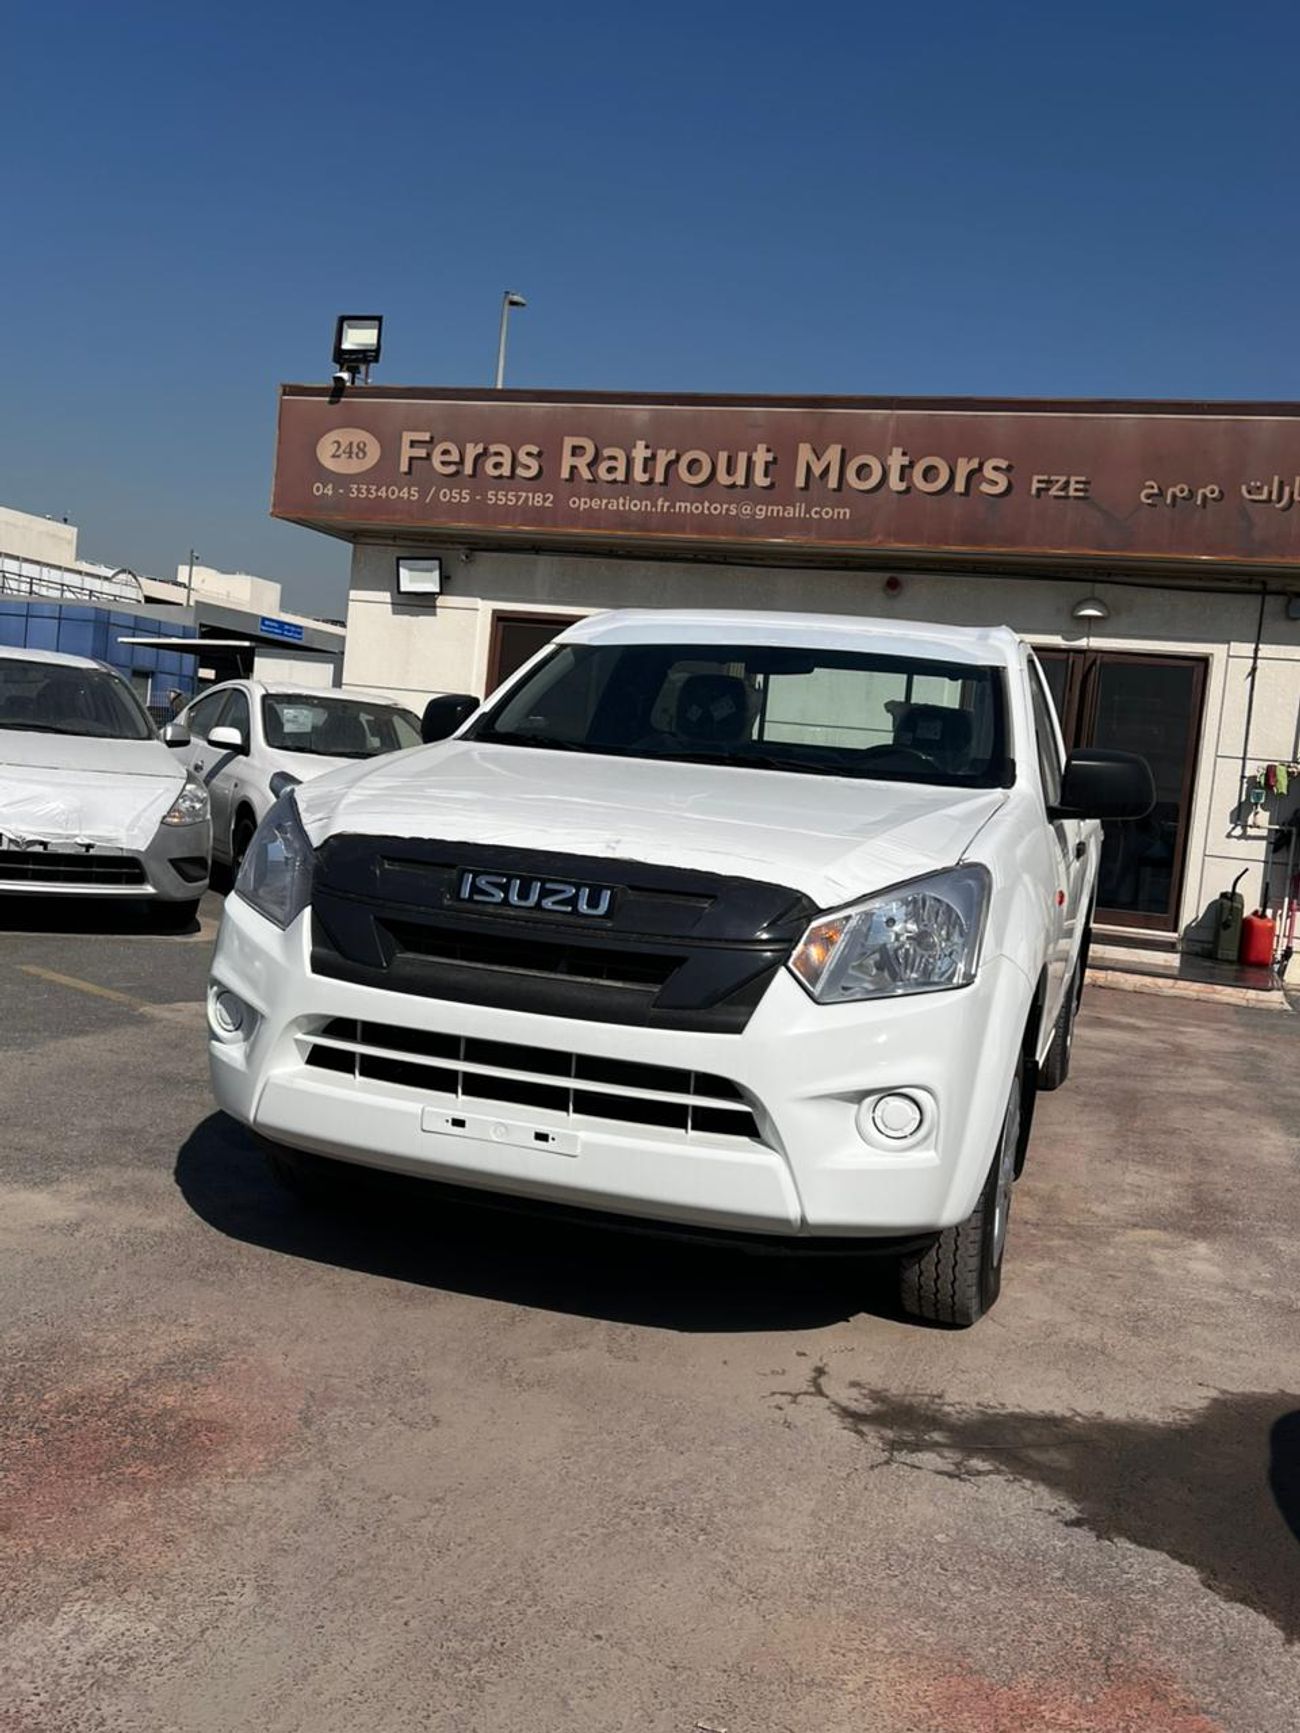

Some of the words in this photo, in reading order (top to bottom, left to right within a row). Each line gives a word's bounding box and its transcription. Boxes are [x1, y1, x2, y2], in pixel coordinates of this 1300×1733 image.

[329, 439, 368, 460] 248
[399, 431, 541, 478] Feras
[560, 436, 774, 487] Ratrout
[795, 443, 1010, 494] Motors
[1031, 475, 1087, 497] FZE
[312, 482, 333, 496] 04
[349, 484, 419, 501] 3334045
[487, 490, 554, 507] 5557182
[568, 495, 851, 520] operation.fr.motors@gmail.com
[459, 872, 611, 916] ISUZU
